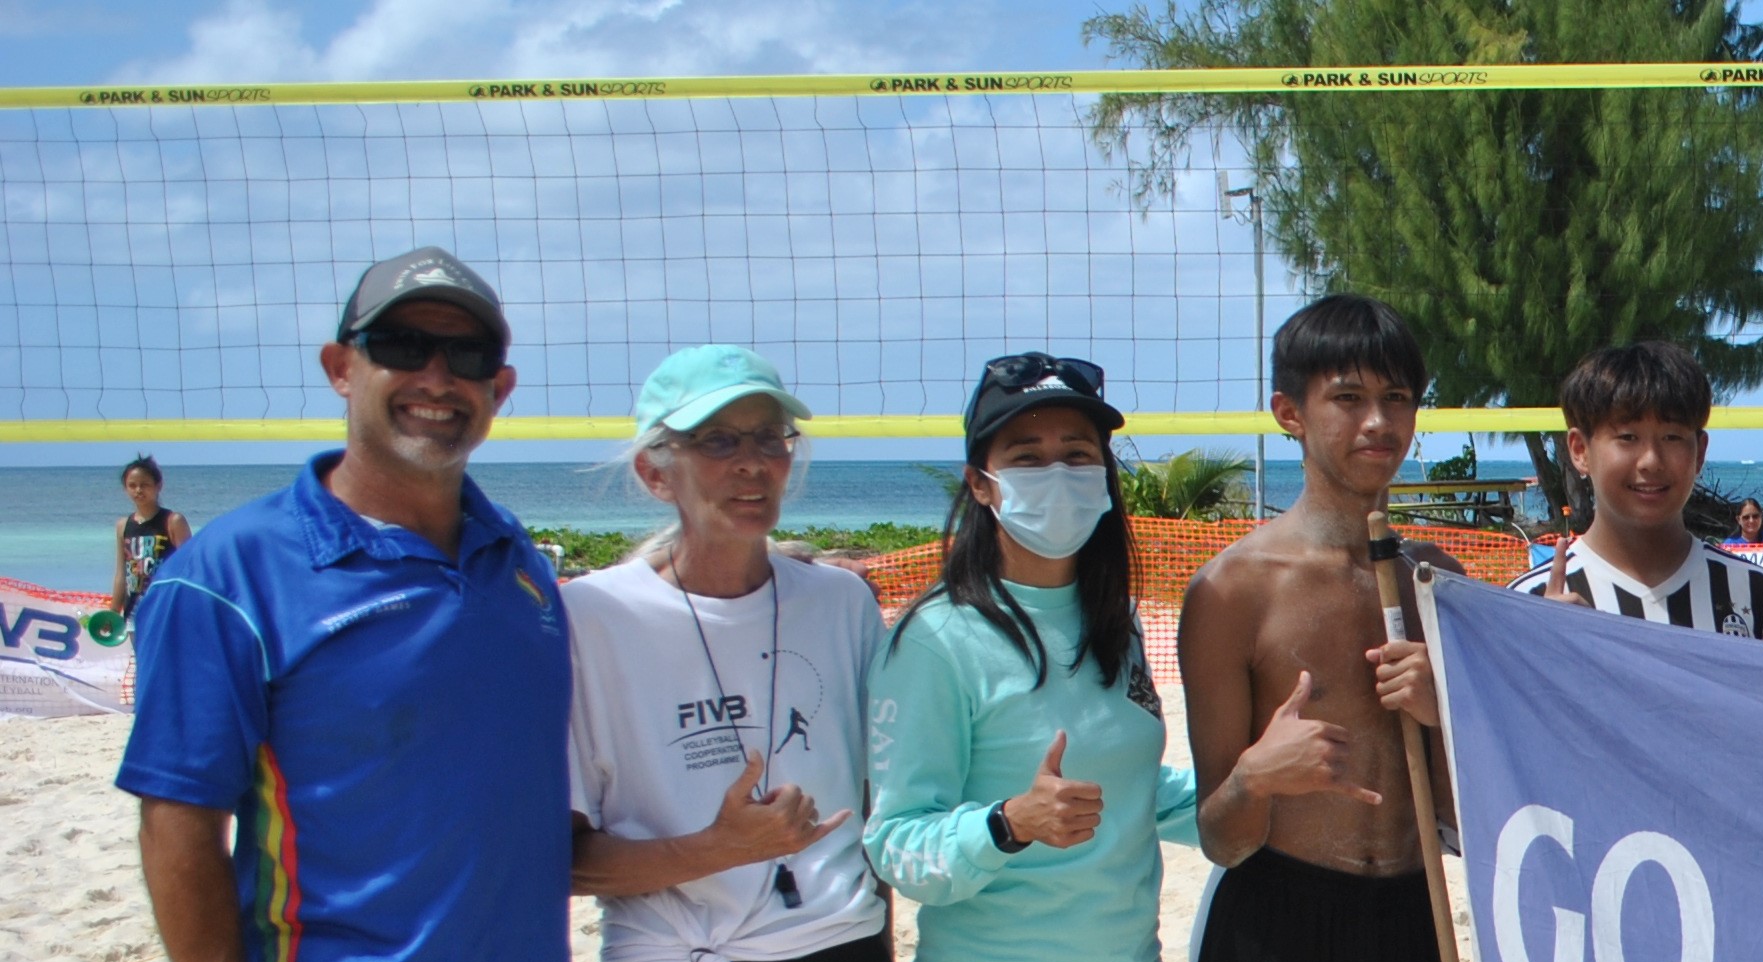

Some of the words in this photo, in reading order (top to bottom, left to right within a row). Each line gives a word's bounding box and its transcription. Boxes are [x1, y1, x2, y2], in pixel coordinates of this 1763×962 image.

[891, 78, 941, 91] PARK
[945, 78, 959, 91] &
[1303, 73, 1353, 86] PARK
[1358, 73, 1372, 86] &
[490, 84, 538, 97] PARK
[542, 84, 555, 96] &
[100, 91, 146, 105] PARK
[151, 90, 164, 104] &
[678, 695, 747, 728] FIVB
